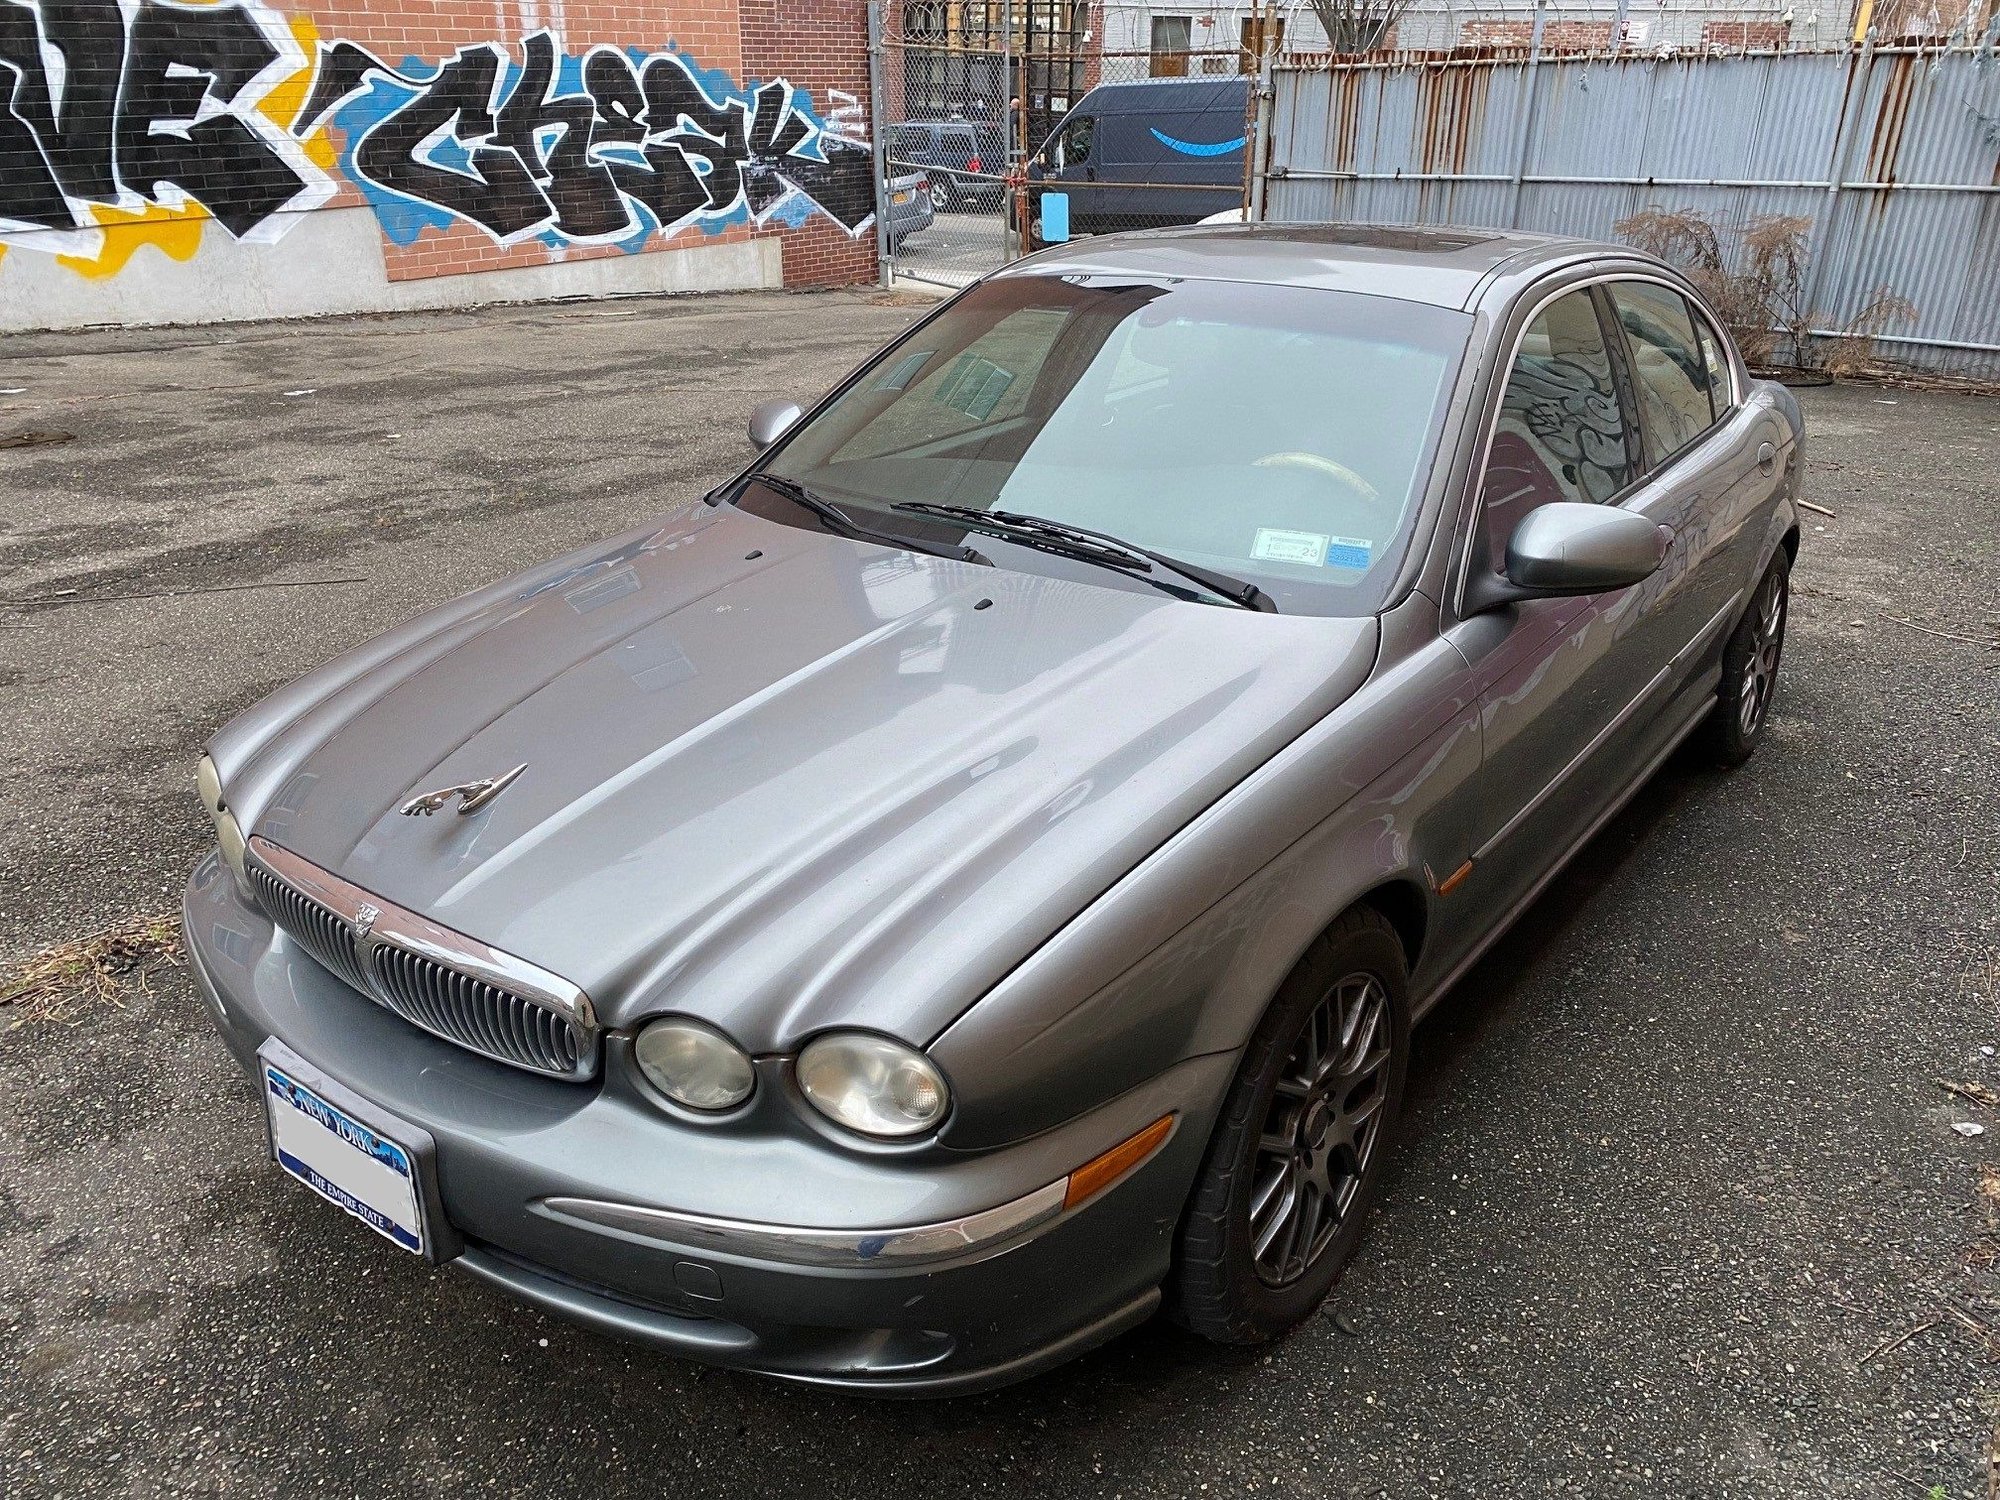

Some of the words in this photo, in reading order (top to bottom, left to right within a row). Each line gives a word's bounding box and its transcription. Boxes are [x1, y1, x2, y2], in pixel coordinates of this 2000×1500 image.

[1302, 547, 1318, 558] 23
[297, 1089, 329, 1127] NEW
[331, 1112, 374, 1156] YORK
[310, 1171, 326, 1191] THE
[327, 1183, 358, 1211] EMPIRE
[358, 1203, 384, 1228] STATE
